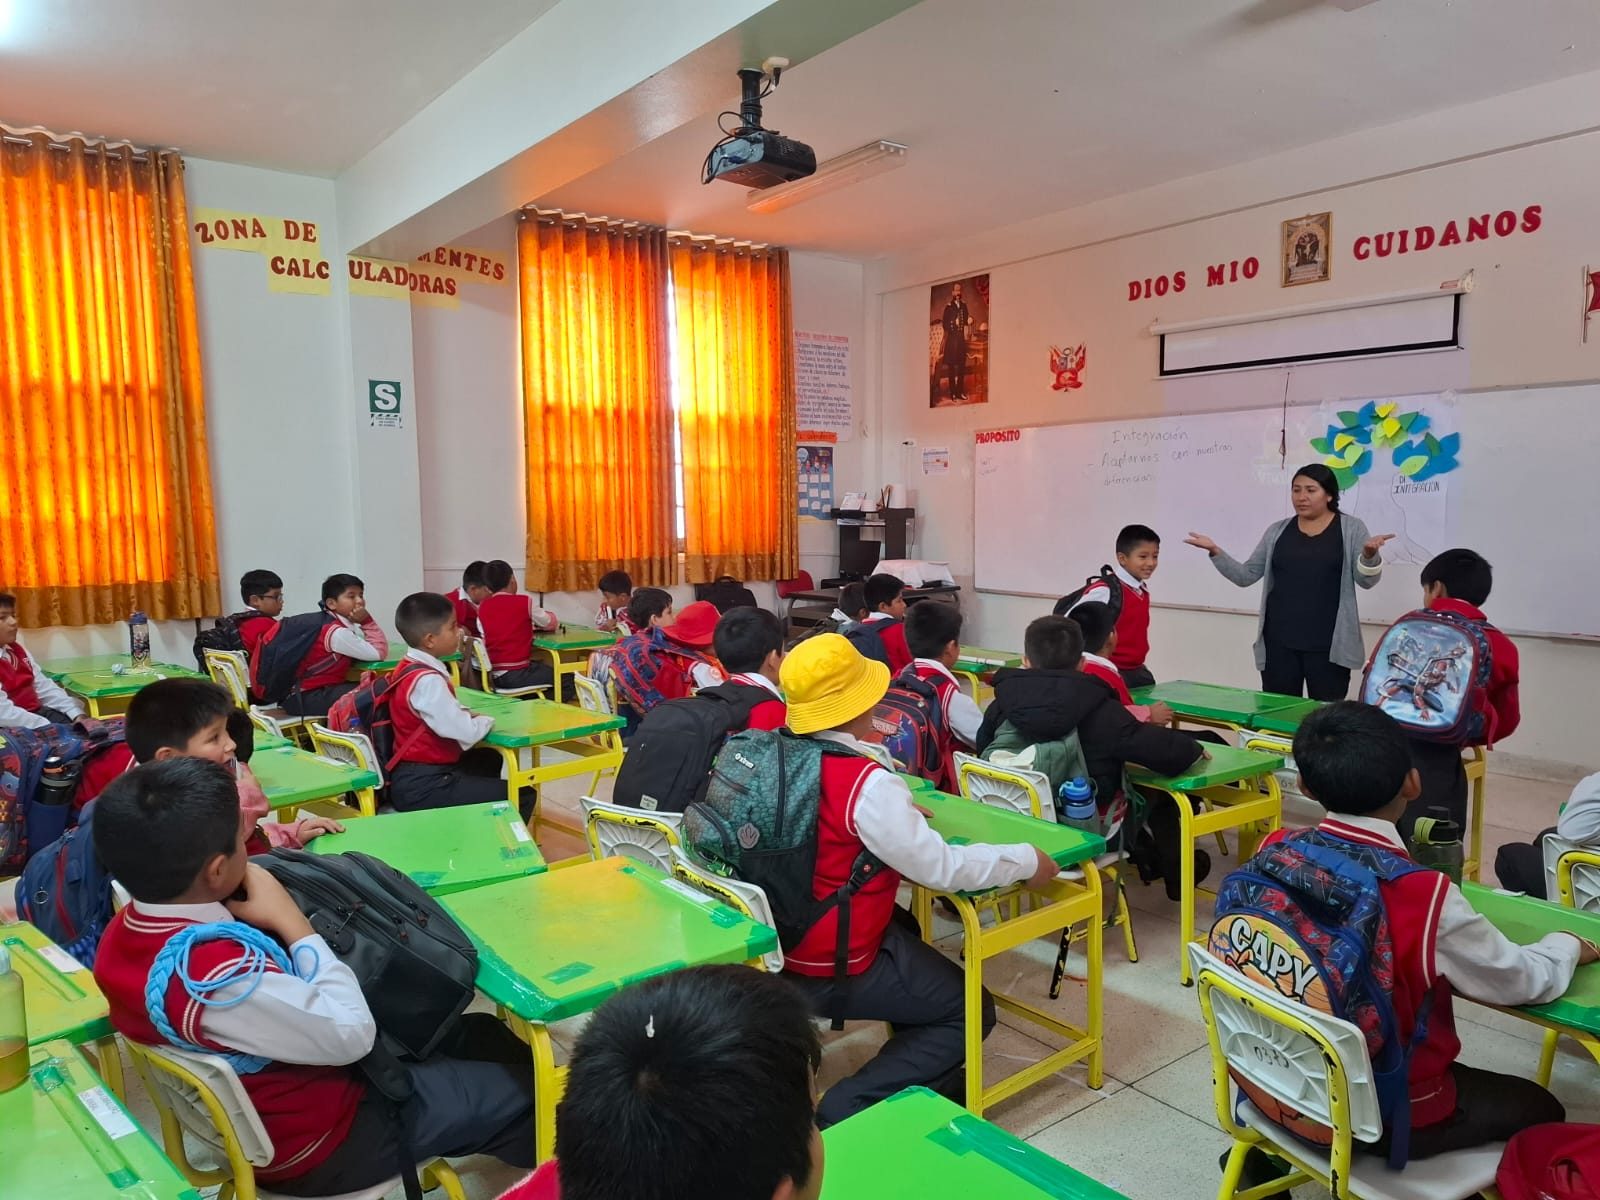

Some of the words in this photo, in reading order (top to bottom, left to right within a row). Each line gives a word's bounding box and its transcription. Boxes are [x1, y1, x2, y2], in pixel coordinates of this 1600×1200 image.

[195, 218, 266, 243] ZONA
[284, 220, 316, 242] DE
[1127, 271, 1186, 301] DIOS
[1206, 257, 1259, 287] MIO
[1353, 205, 1542, 260] CUIDANOS
[375, 384, 398, 410] S
[1229, 917, 1319, 1000] CAPY
